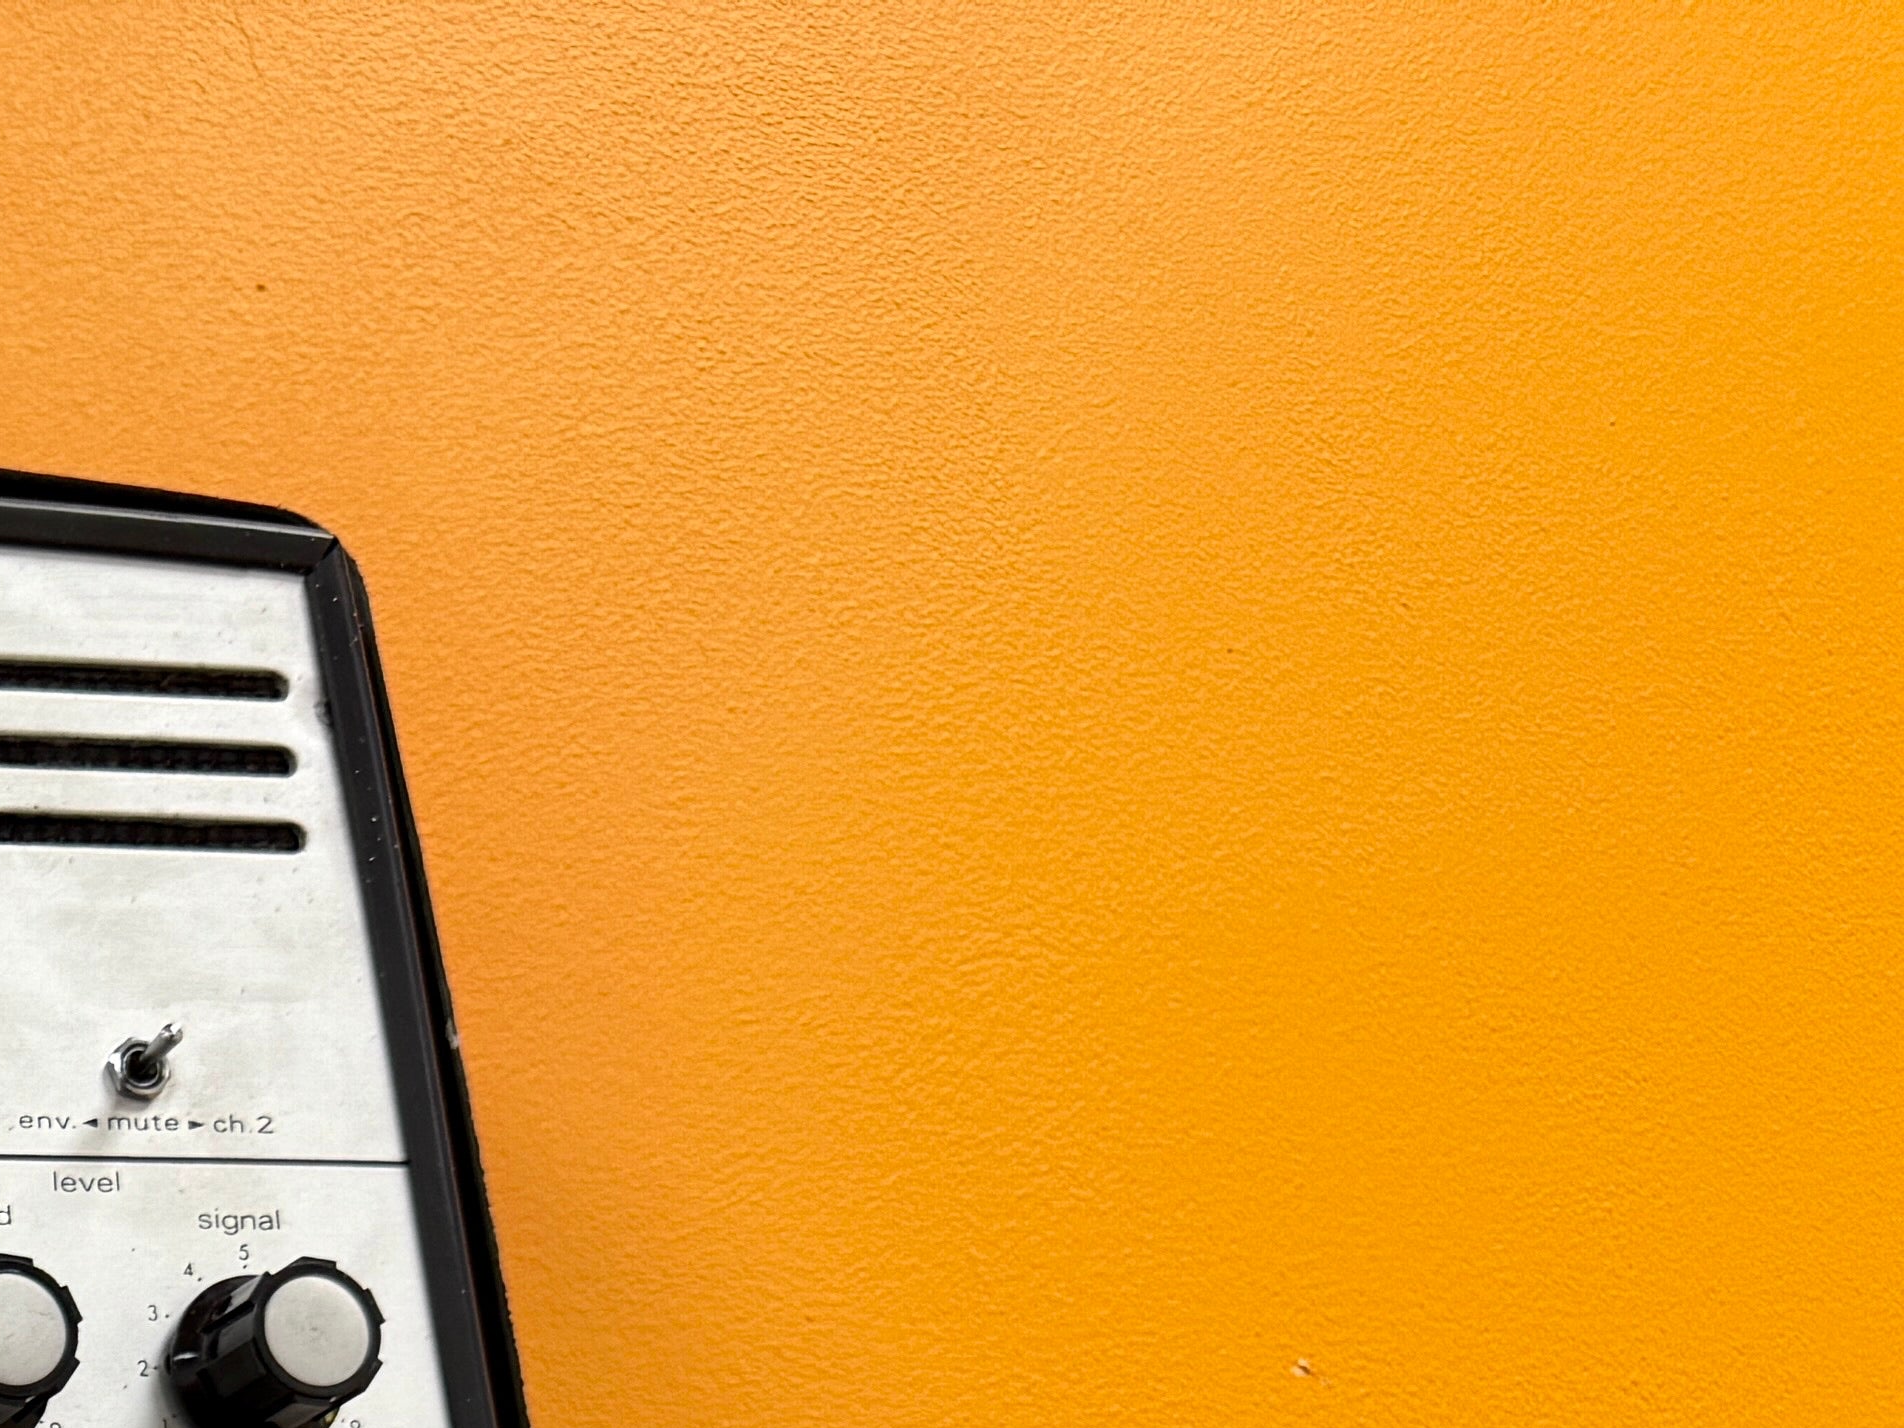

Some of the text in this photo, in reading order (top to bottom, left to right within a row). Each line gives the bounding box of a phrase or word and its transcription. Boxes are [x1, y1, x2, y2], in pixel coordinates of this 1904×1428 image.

[104, 1113, 181, 1133] mute
[52, 1169, 122, 1194] level
[197, 1208, 282, 1237] signal
